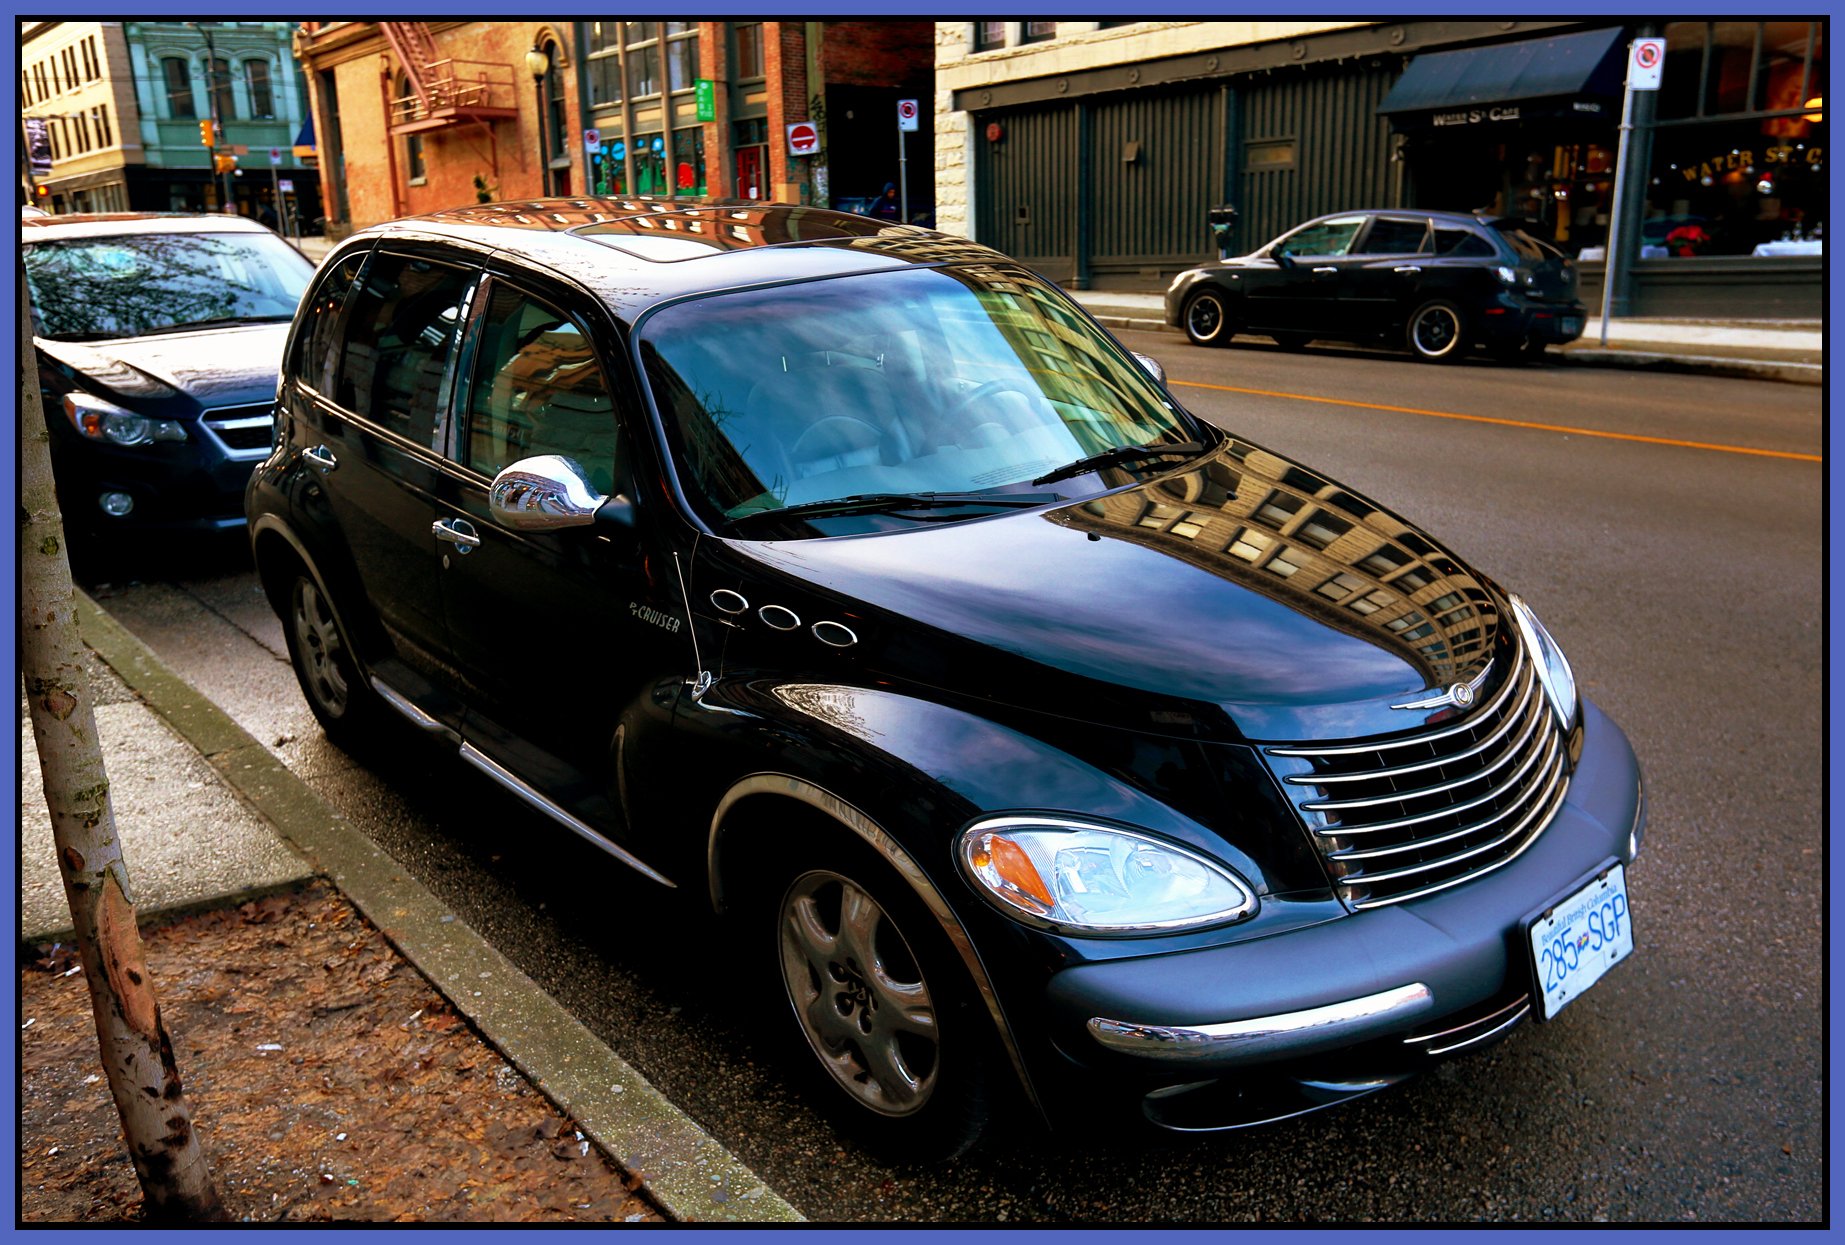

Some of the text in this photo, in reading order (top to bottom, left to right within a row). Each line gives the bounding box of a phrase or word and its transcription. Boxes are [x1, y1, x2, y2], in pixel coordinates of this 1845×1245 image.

[1682, 150, 1753, 181] WATER
[638, 605, 680, 633] CRUISER
[1566, 904, 1587, 927] British
[1586, 884, 1618, 911] Columbia
[1541, 893, 1626, 994] 285 SGP
